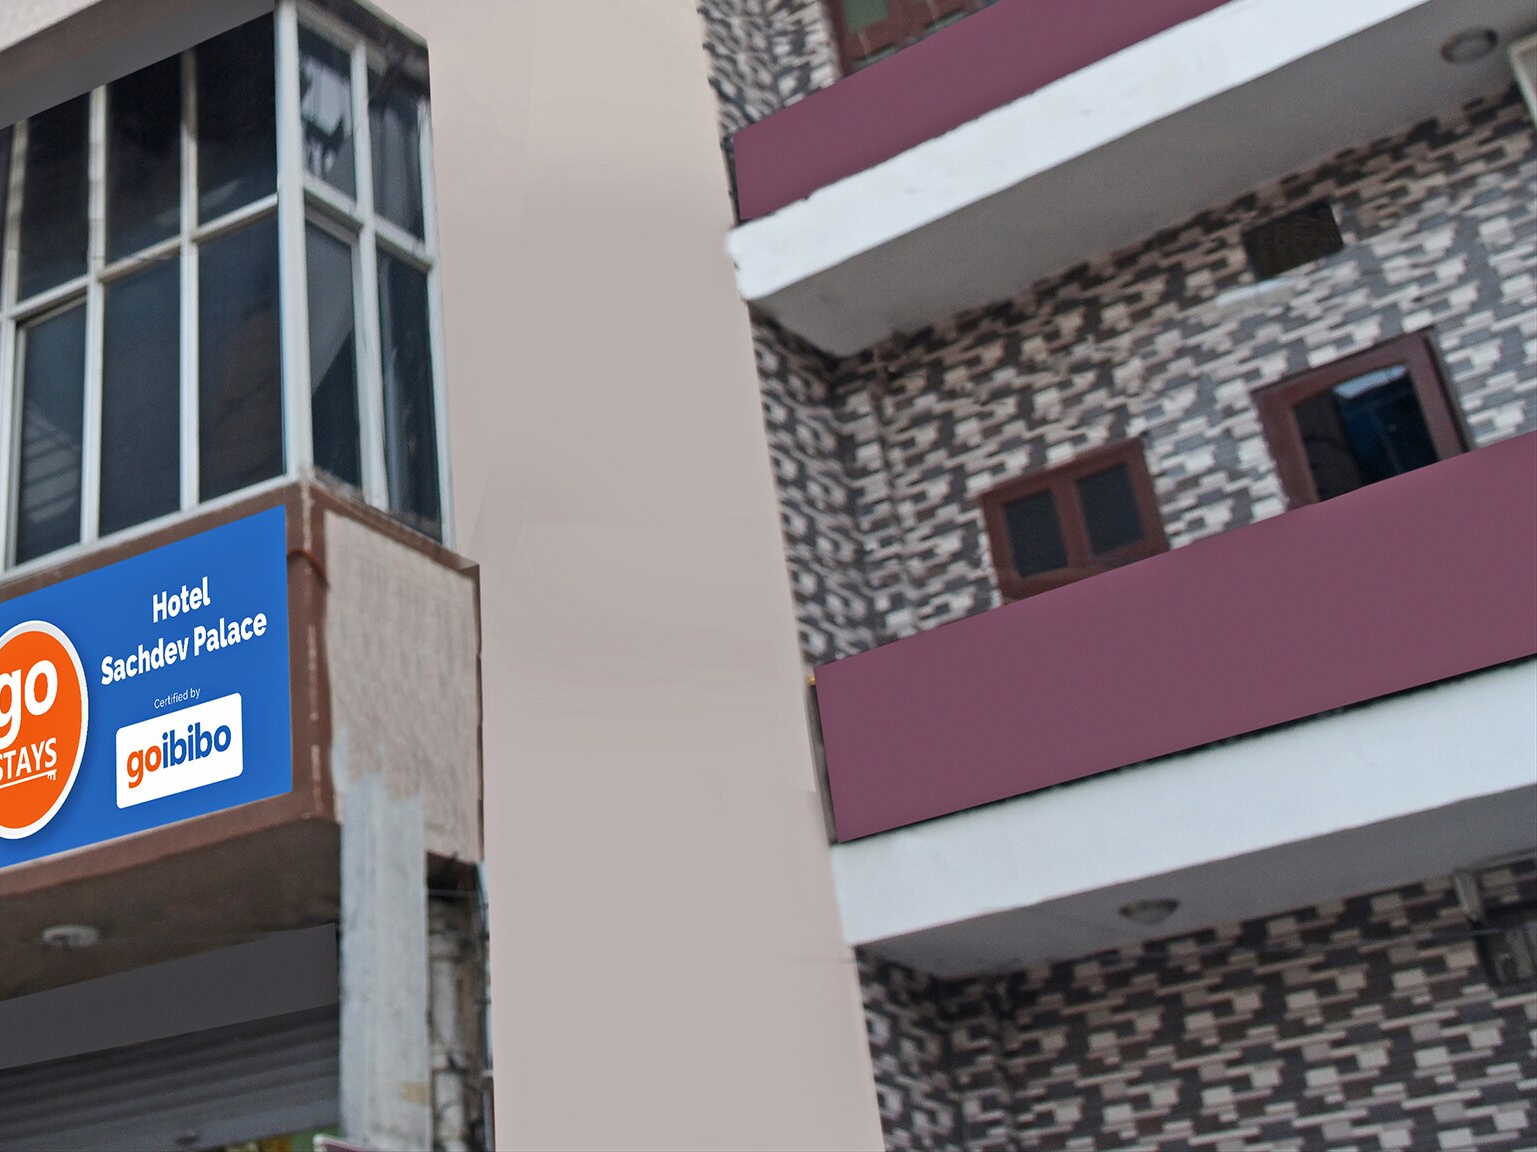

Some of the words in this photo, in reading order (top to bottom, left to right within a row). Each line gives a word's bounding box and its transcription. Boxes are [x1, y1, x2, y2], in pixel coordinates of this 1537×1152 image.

[152, 575, 211, 623] Hotel
[100, 636, 189, 685] Sachdev
[193, 612, 267, 657] Palace
[154, 691, 188, 709] Certified
[190, 686, 201, 701] by
[126, 721, 232, 788] goibibo
